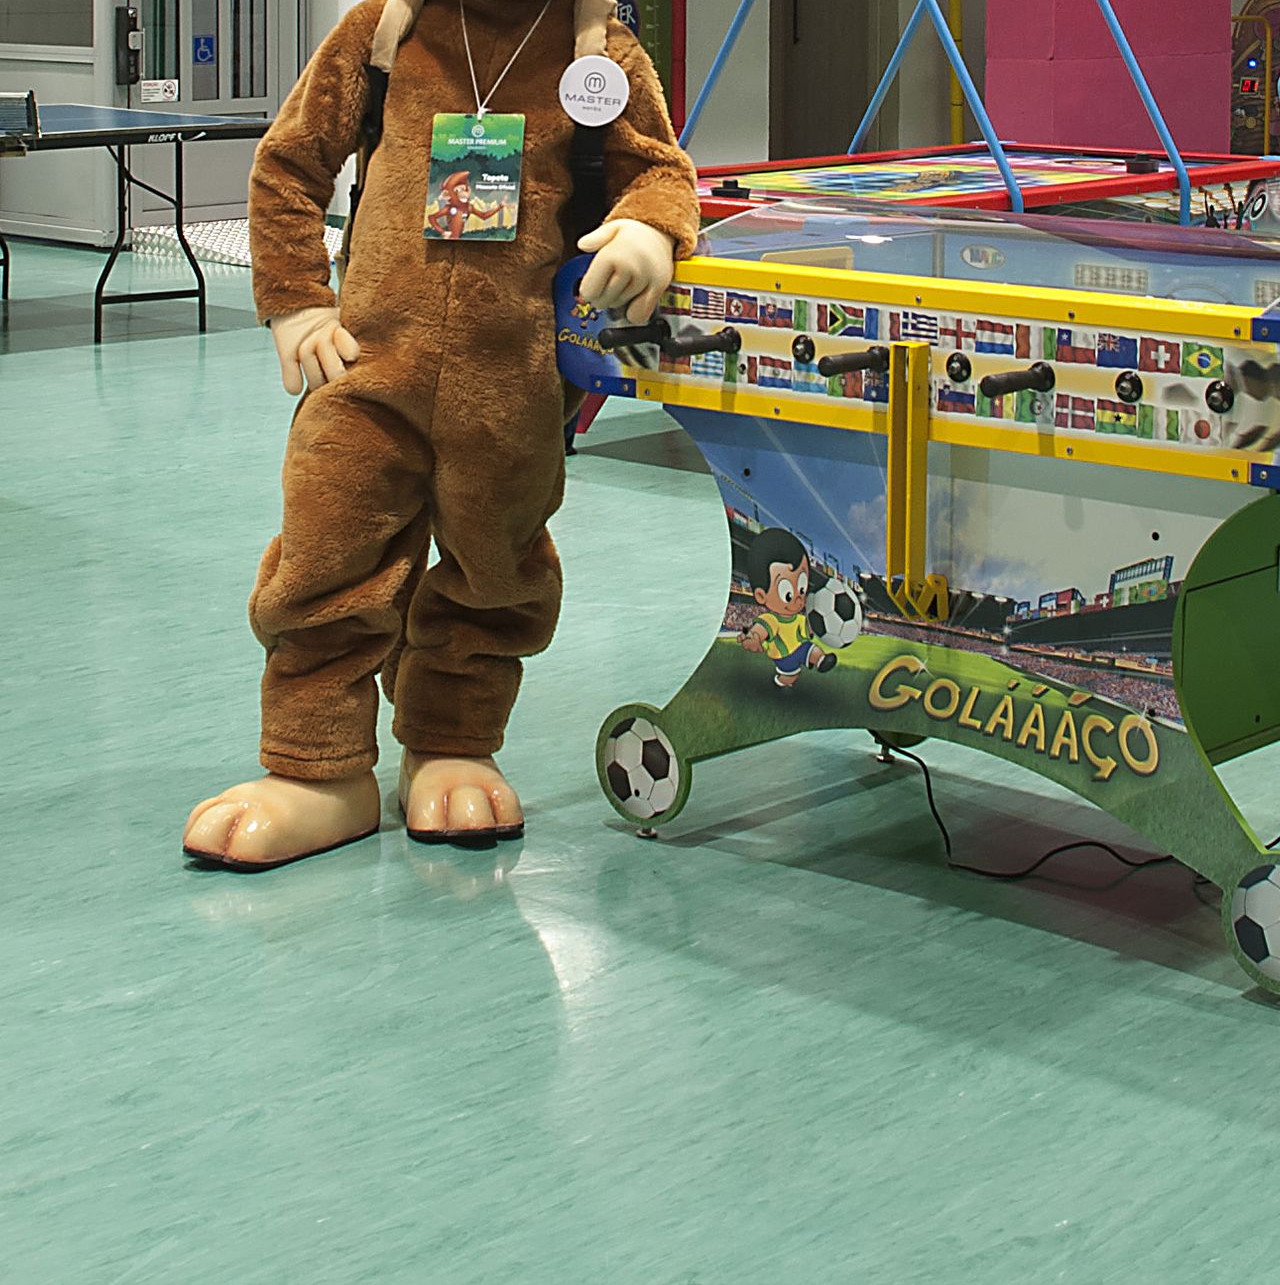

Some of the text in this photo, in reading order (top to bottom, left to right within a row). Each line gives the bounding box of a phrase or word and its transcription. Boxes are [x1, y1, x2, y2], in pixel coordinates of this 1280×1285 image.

[564, 92, 622, 106] MASTER
[447, 138, 508, 146] MASTER PREMIUM
